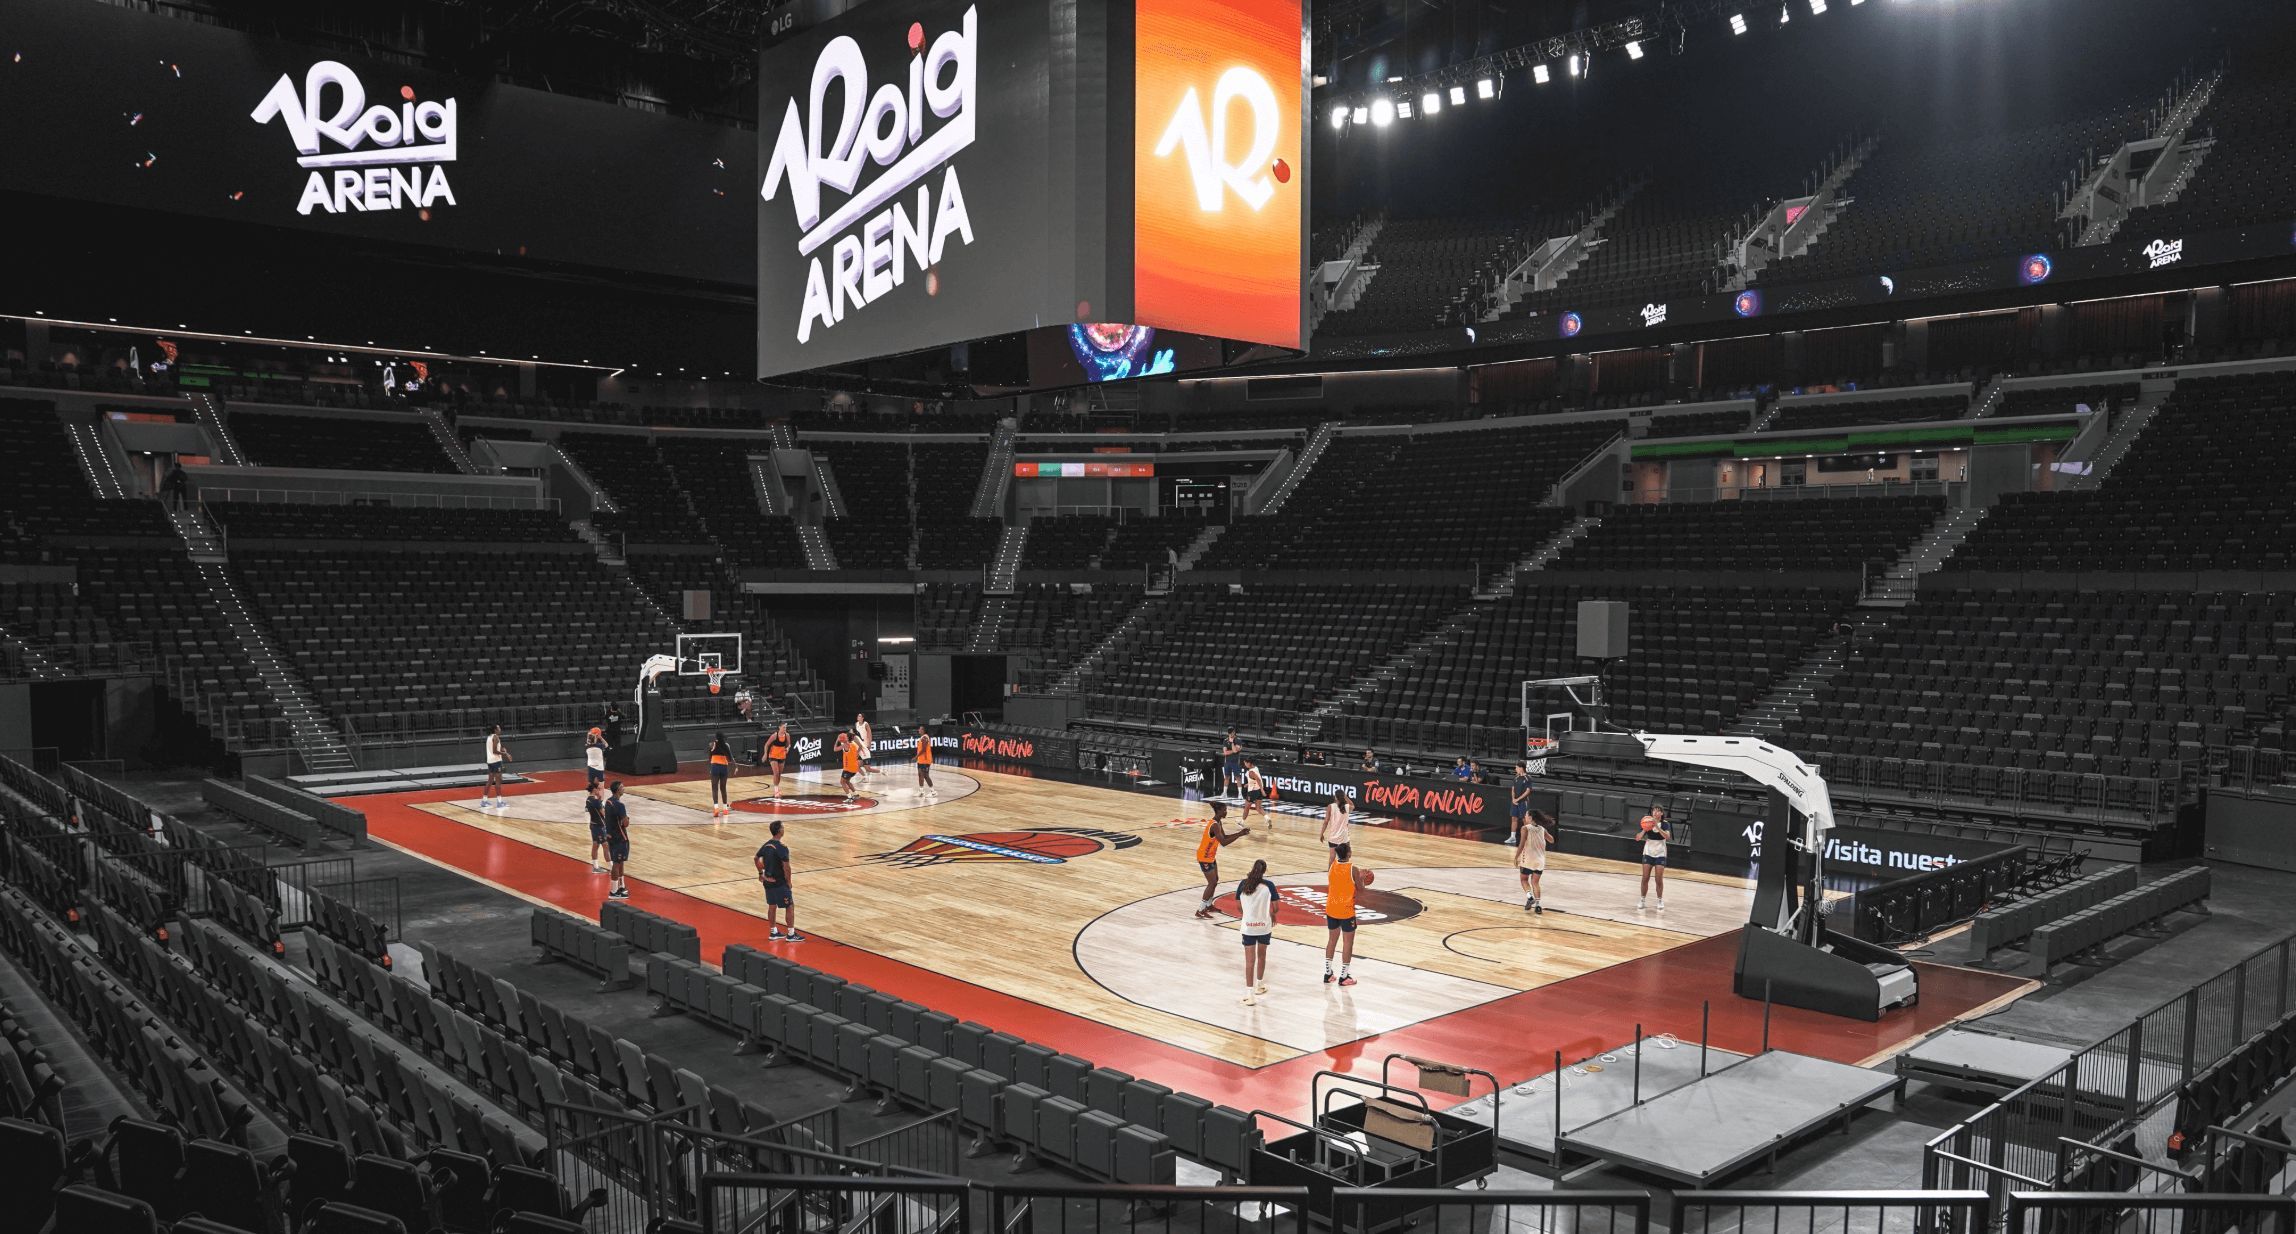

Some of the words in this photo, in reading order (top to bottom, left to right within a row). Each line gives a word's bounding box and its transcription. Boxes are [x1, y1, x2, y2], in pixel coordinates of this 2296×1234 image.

[296, 165, 457, 215] ARENA
[797, 164, 975, 344] ARENA
[2150, 252, 2181, 268] ARENA
[880, 736, 920, 751] nuestr
[930, 736, 959, 748] nueva
[800, 750, 822, 762] ARENA
[1778, 773, 1804, 797] SPALDING
